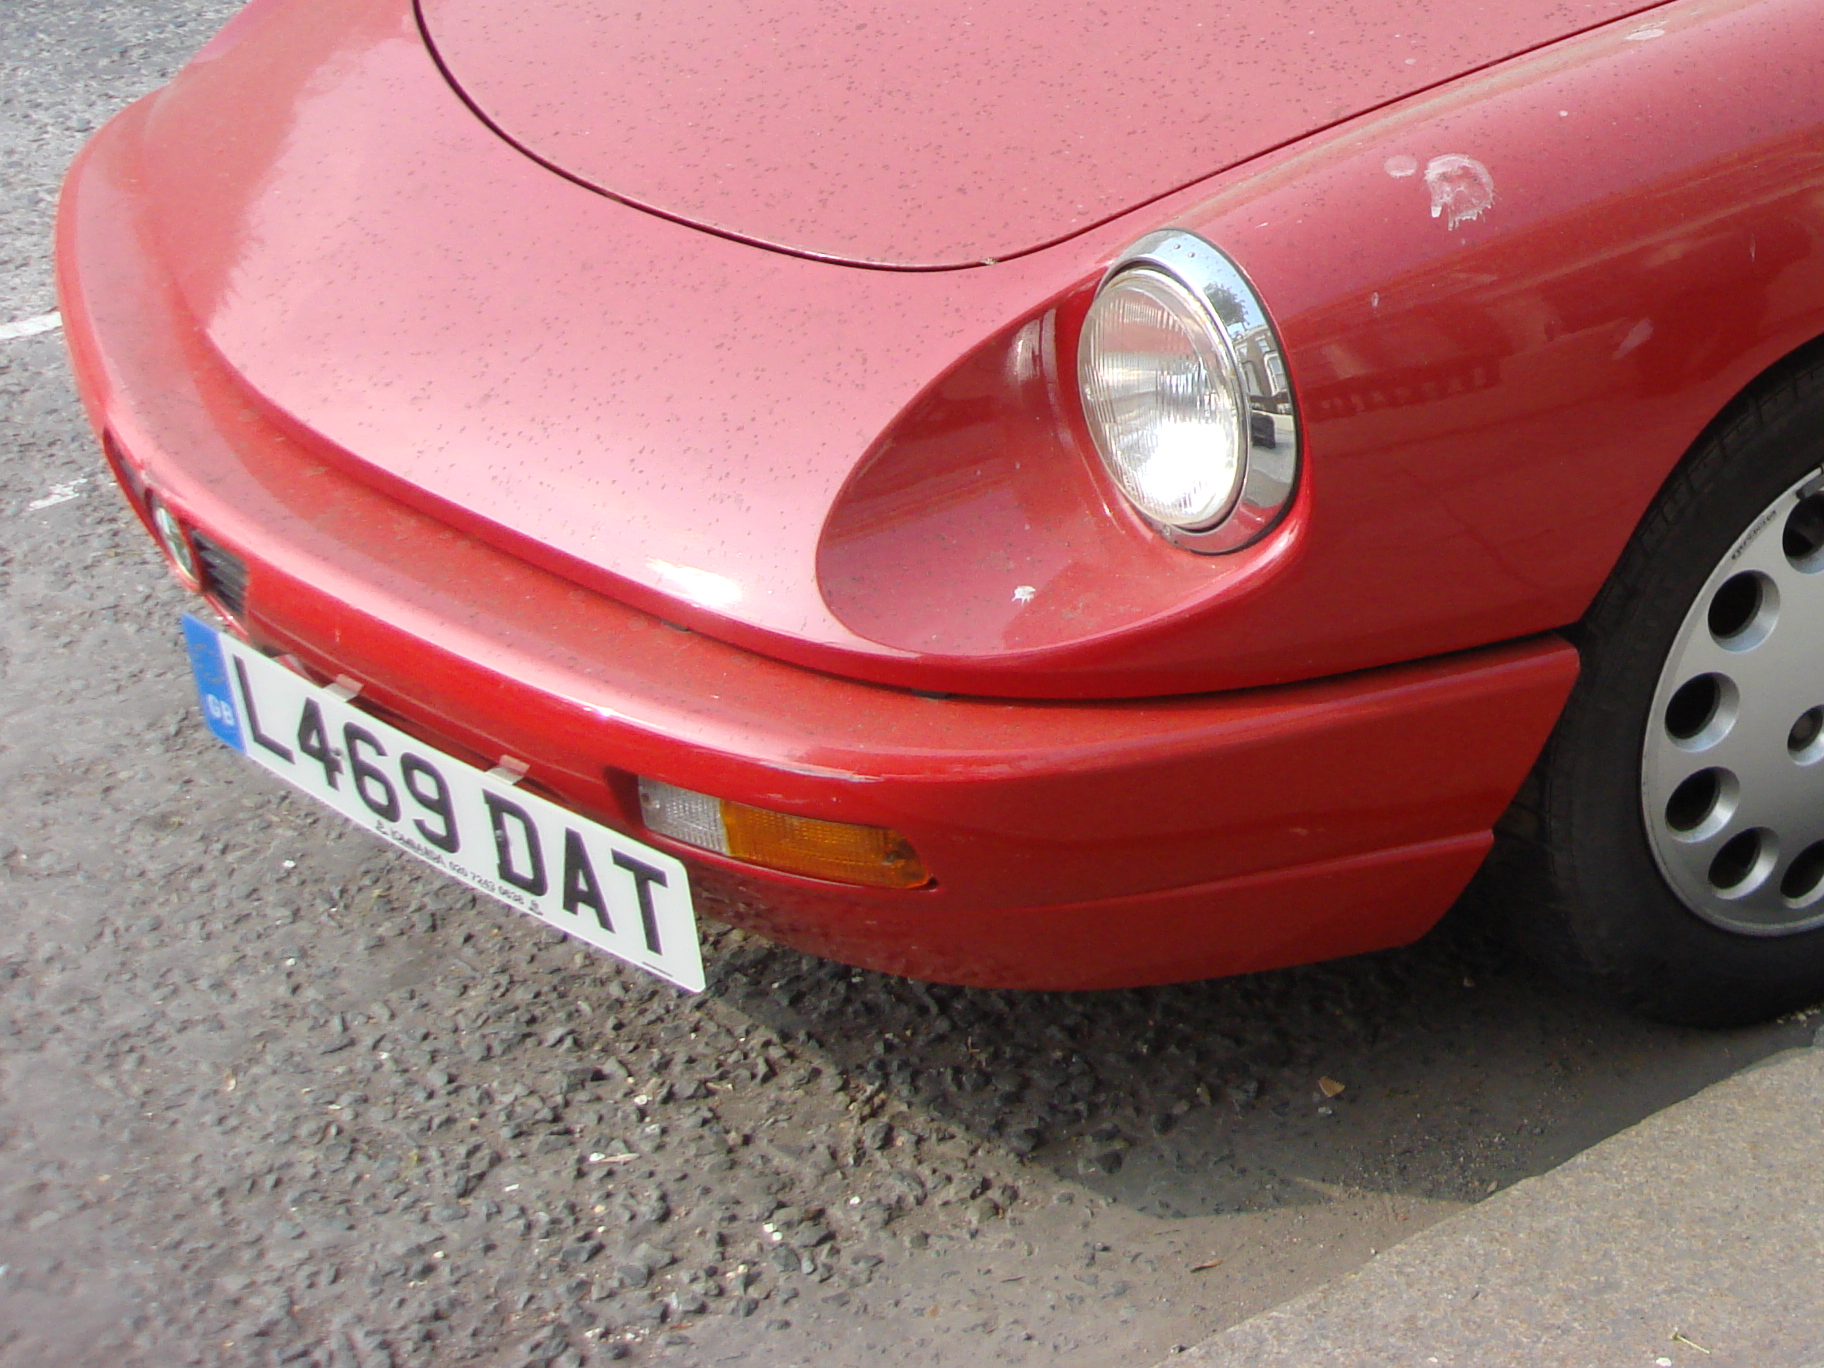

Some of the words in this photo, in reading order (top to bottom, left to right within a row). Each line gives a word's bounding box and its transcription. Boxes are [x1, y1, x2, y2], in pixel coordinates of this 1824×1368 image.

[206, 693, 235, 726] GB
[232, 654, 460, 854] L469
[481, 787, 669, 957] DAT
